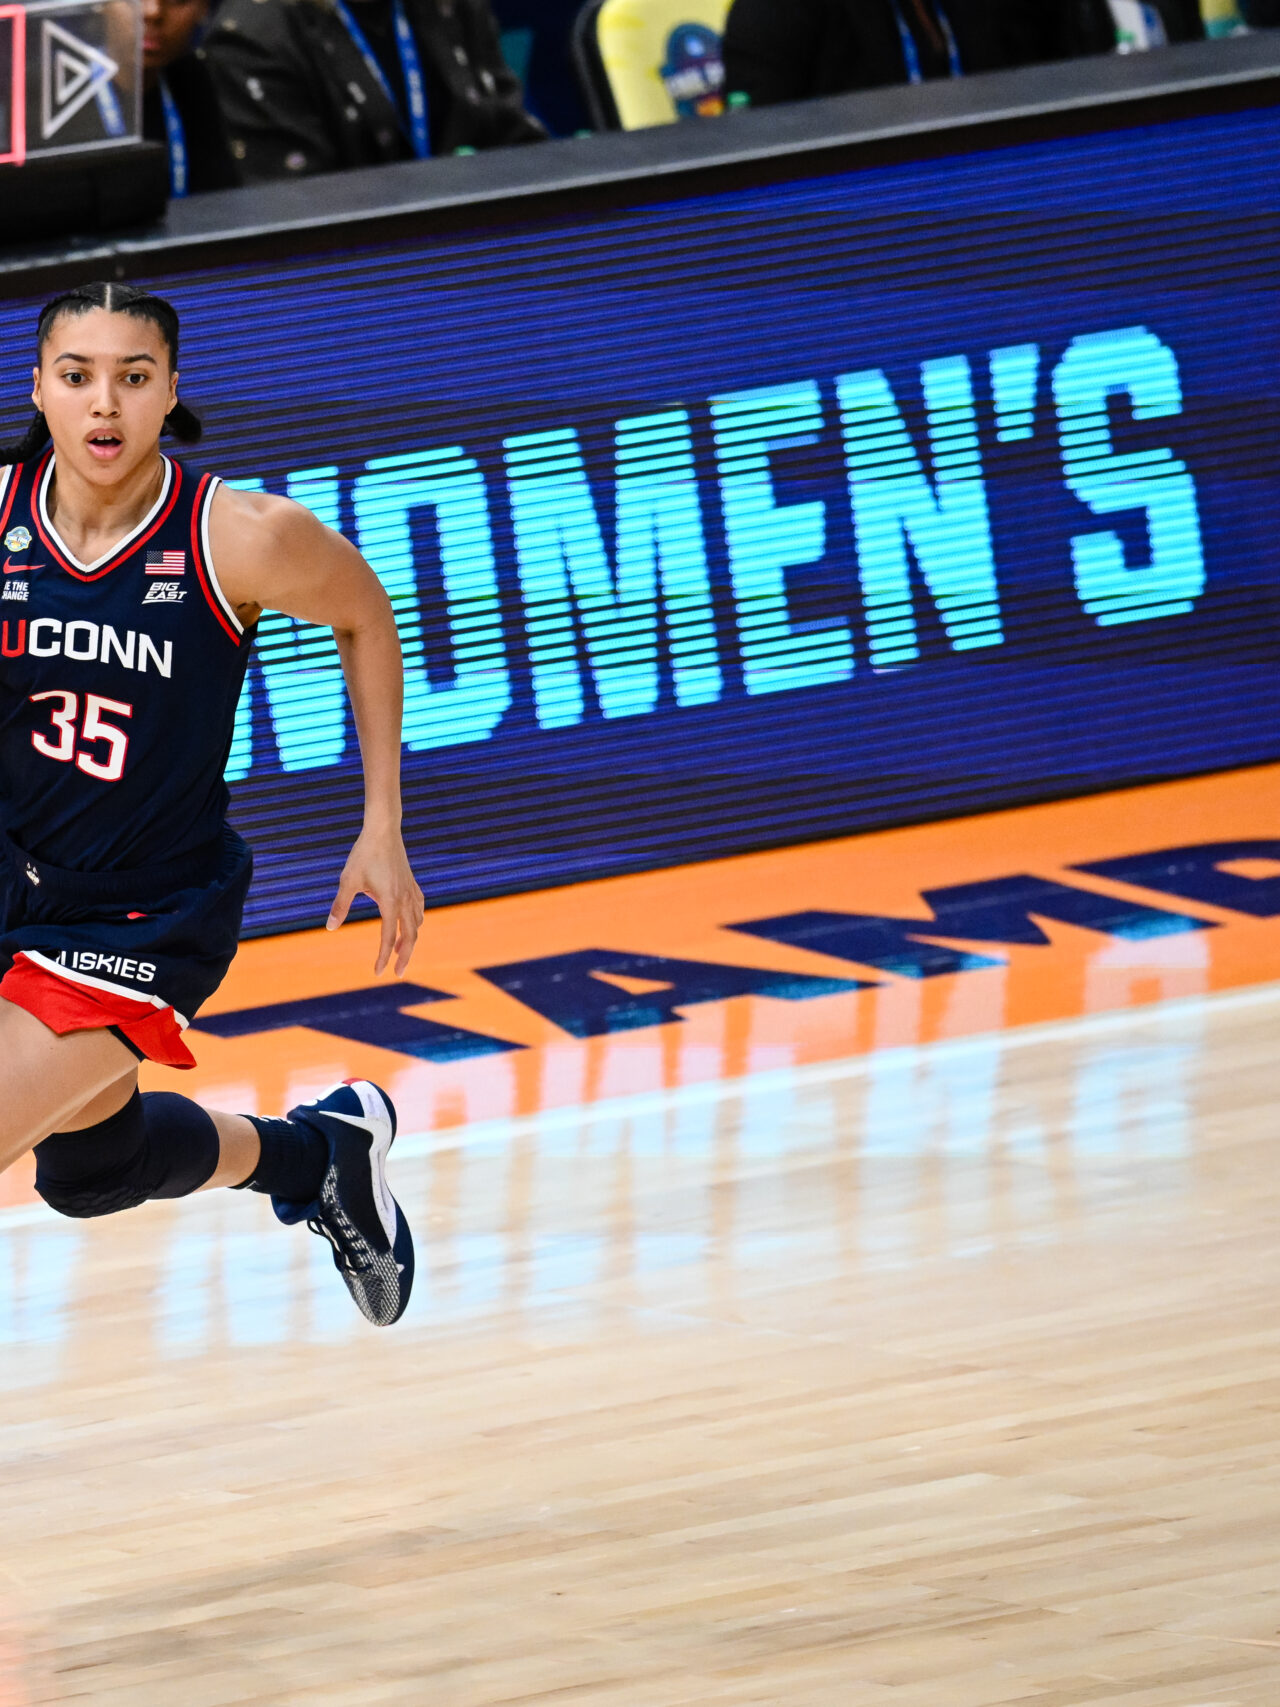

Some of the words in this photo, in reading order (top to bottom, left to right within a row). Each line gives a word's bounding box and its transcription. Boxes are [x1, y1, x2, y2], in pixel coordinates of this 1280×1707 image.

[12, 581, 29, 591] THE
[150, 582, 180, 591] BIG
[145, 591, 187, 600] EAST
[1, 617, 172, 678] UCONN
[29, 690, 133, 782] 35
